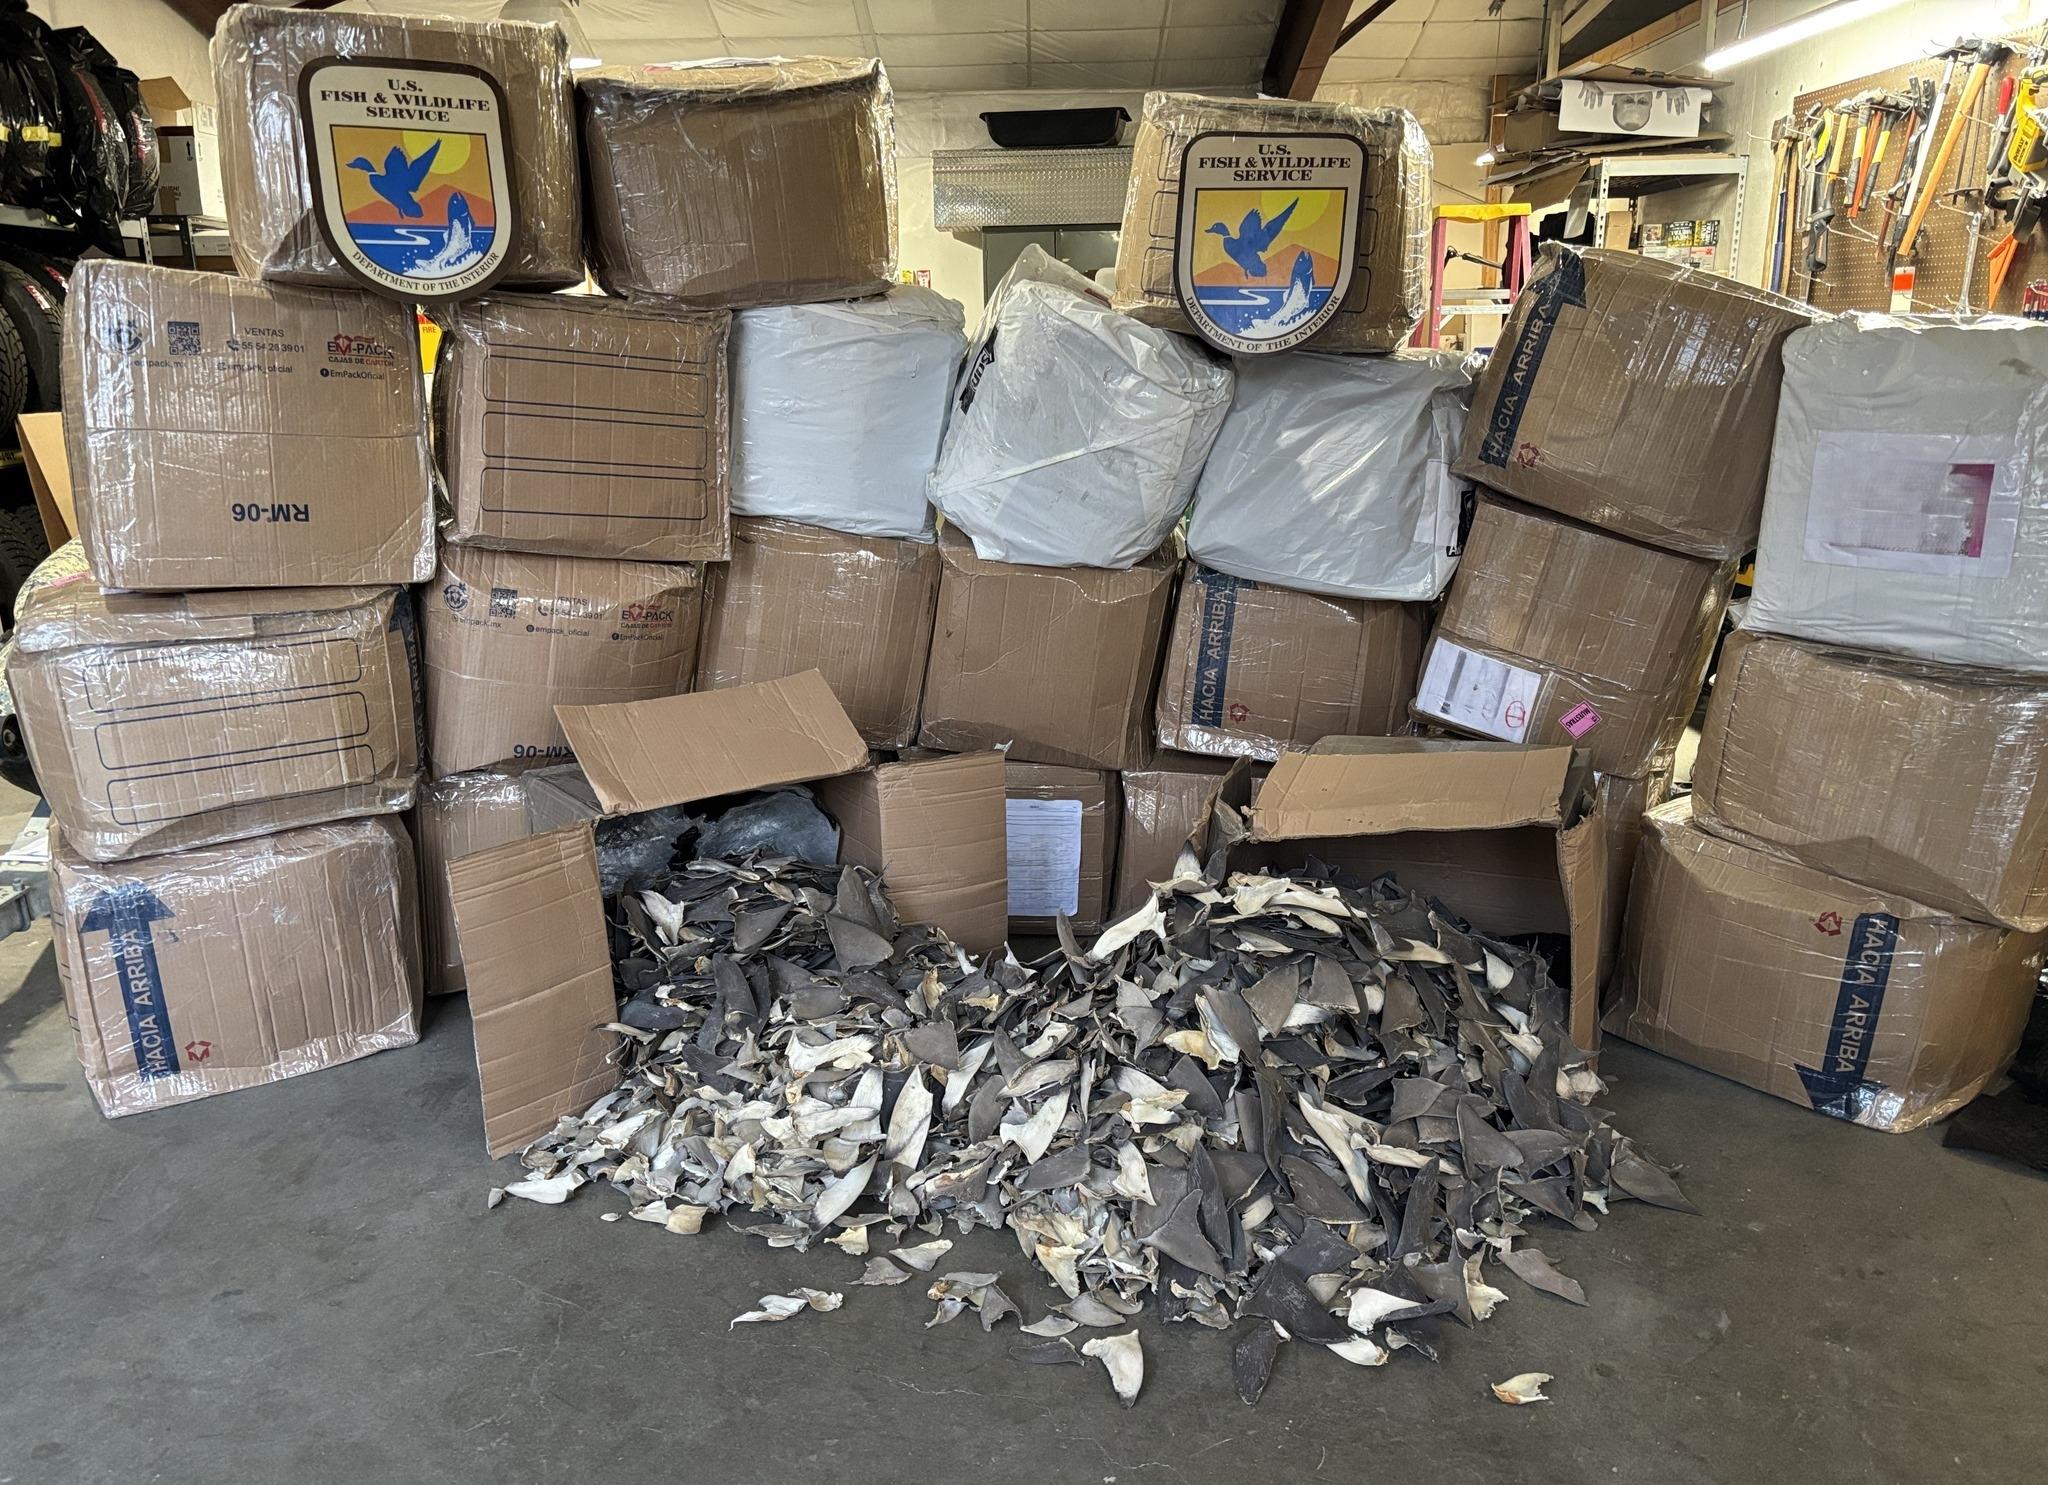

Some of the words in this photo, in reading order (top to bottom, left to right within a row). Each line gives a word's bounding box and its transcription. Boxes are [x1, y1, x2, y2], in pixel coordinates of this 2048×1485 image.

[387, 78, 423, 93] U.S.
[320, 89, 367, 103] FISH
[373, 92, 388, 104] &
[394, 93, 490, 112] WILDLIFE
[366, 106, 450, 122] SERVICE
[1258, 144, 1291, 156] U.S.
[1198, 156, 1240, 169] FISH
[1244, 156, 1258, 168] &
[1261, 157, 1351, 169] WILDLIFE
[1233, 169, 1312, 182] SERVICE
[352, 251, 420, 291] DEPARTMENT
[422, 283, 437, 292] OF
[438, 280, 460, 291] THE
[460, 252, 500, 285] INTERIOR
[244, 327, 285, 337] VENTAS
[1186, 296, 1244, 349] DEPARTMENT
[1246, 342, 1261, 351] OF
[1266, 337, 1292, 350] THE
[1294, 295, 1341, 342] INTERIOR
[241, 341, 253, 350] 55
[1487, 394, 1519, 458] HACIA
[1512, 303, 1550, 387] ARRIBA
[231, 503, 310, 522] RM-06
[1206, 590, 1228, 660] ARRIBA
[1199, 668, 1219, 721] HACIA
[1566, 707, 1591, 729] MUESTRAS
[1857, 918, 1889, 986] HACIA
[120, 928, 153, 1006] ARRIBA
[138, 1014, 167, 1073] HACIA
[1835, 994, 1870, 1073] ARRIBA
